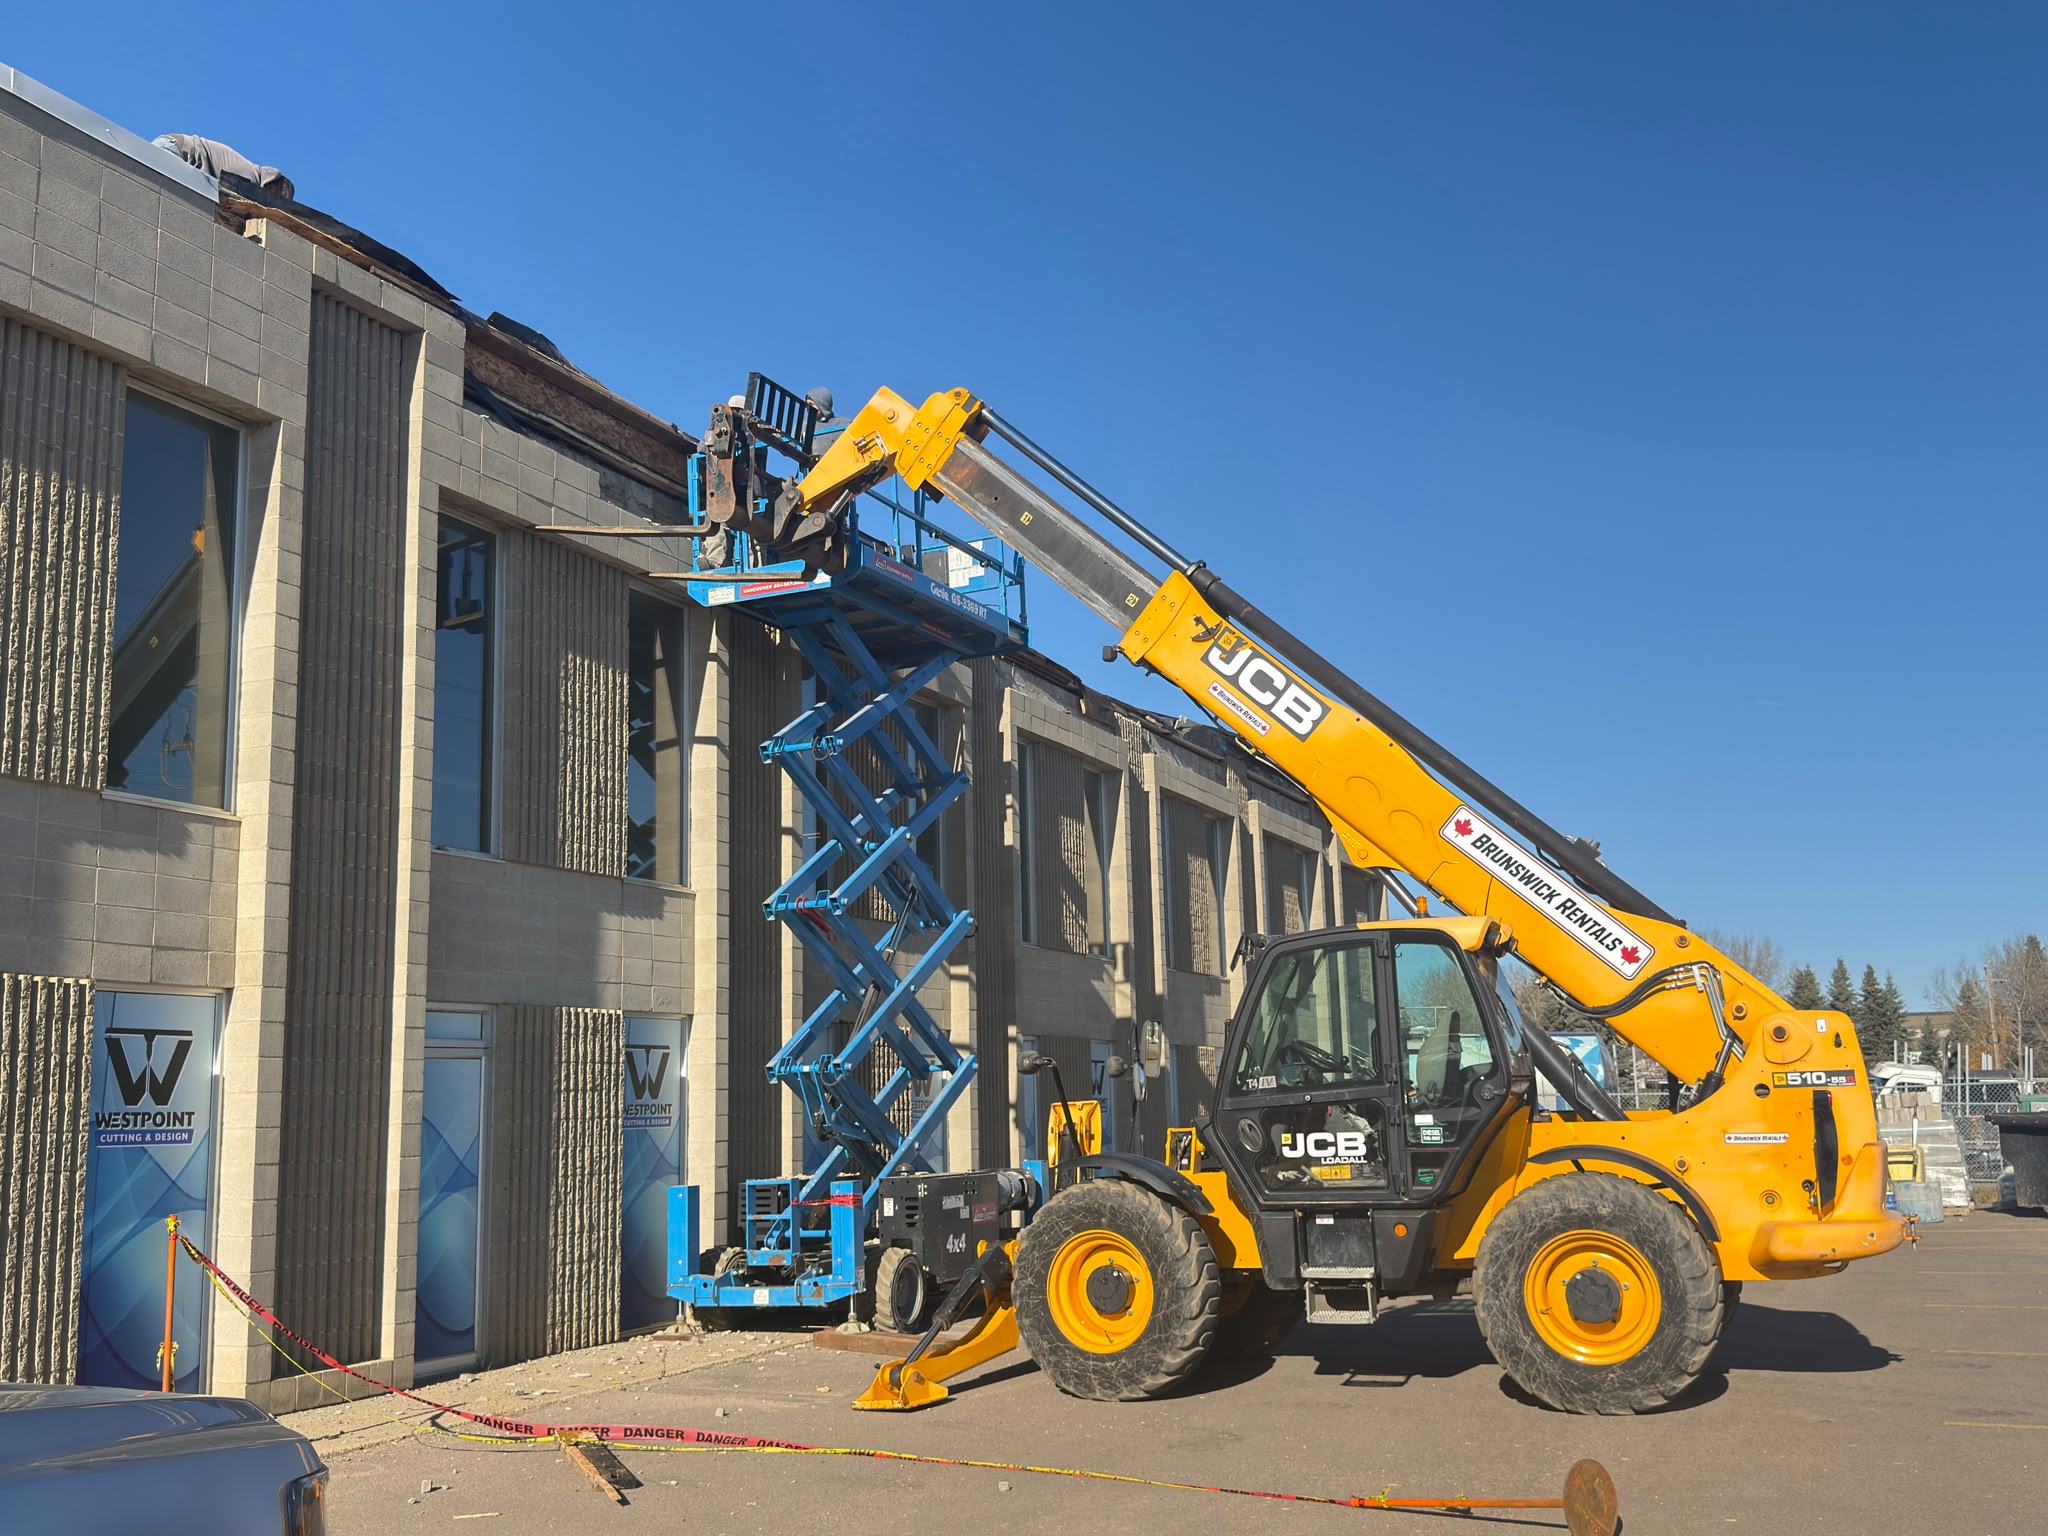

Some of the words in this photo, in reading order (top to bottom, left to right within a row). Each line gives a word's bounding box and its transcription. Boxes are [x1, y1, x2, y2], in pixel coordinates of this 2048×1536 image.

[930, 582, 950, 602] Genie
[951, 592, 979, 615] GS-3369
[979, 605, 988, 620] RT
[1207, 646, 1323, 735] JCB
[1217, 689, 1244, 714] BRUNSWICK
[1242, 710, 1263, 728] RENTALS
[1470, 833, 1561, 905] BRUNSWICK
[1555, 897, 1624, 952] RENTALS
[95, 1111, 195, 1129] WESTPOINT
[651, 1118, 670, 1126] DESIGN
[100, 1132, 143, 1143] CUTTING
[145, 1132, 152, 1142] &
[154, 1131, 189, 1142] DESIGN
[1281, 1131, 1367, 1158] JCB
[1321, 1156, 1368, 1165] LOADALL
[946, 1232, 967, 1253] 4x4
[473, 1415, 534, 1435] DANGER
[623, 1427, 685, 1440] DANGER
[696, 1431, 748, 1446] DANGER
